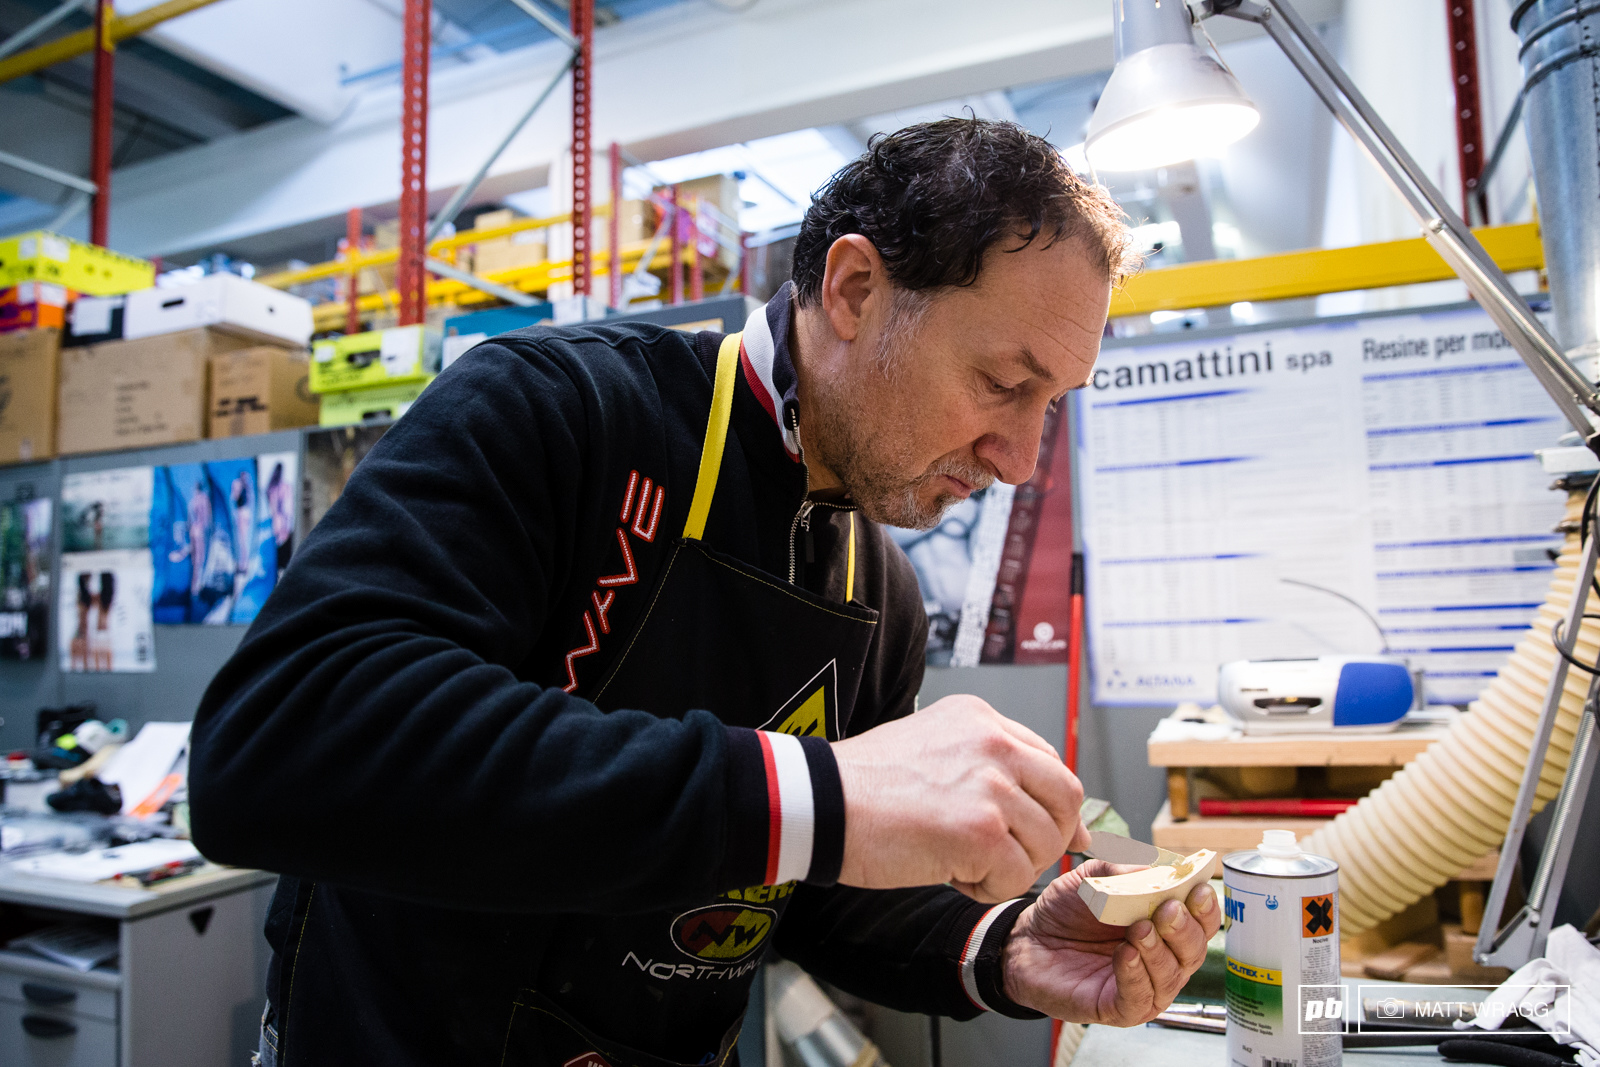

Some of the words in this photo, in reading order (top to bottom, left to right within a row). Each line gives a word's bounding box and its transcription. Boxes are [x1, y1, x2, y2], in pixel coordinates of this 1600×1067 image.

[1362, 336, 1429, 362] Resine
[1434, 334, 1465, 362] per
[1093, 342, 1273, 391] camattini
[1286, 349, 1333, 373] spa
[687, 919, 770, 948] NW
[621, 950, 762, 980] NORTHWAV
[1228, 960, 1258, 978] POLITEX
[1267, 973, 1274, 981] L
